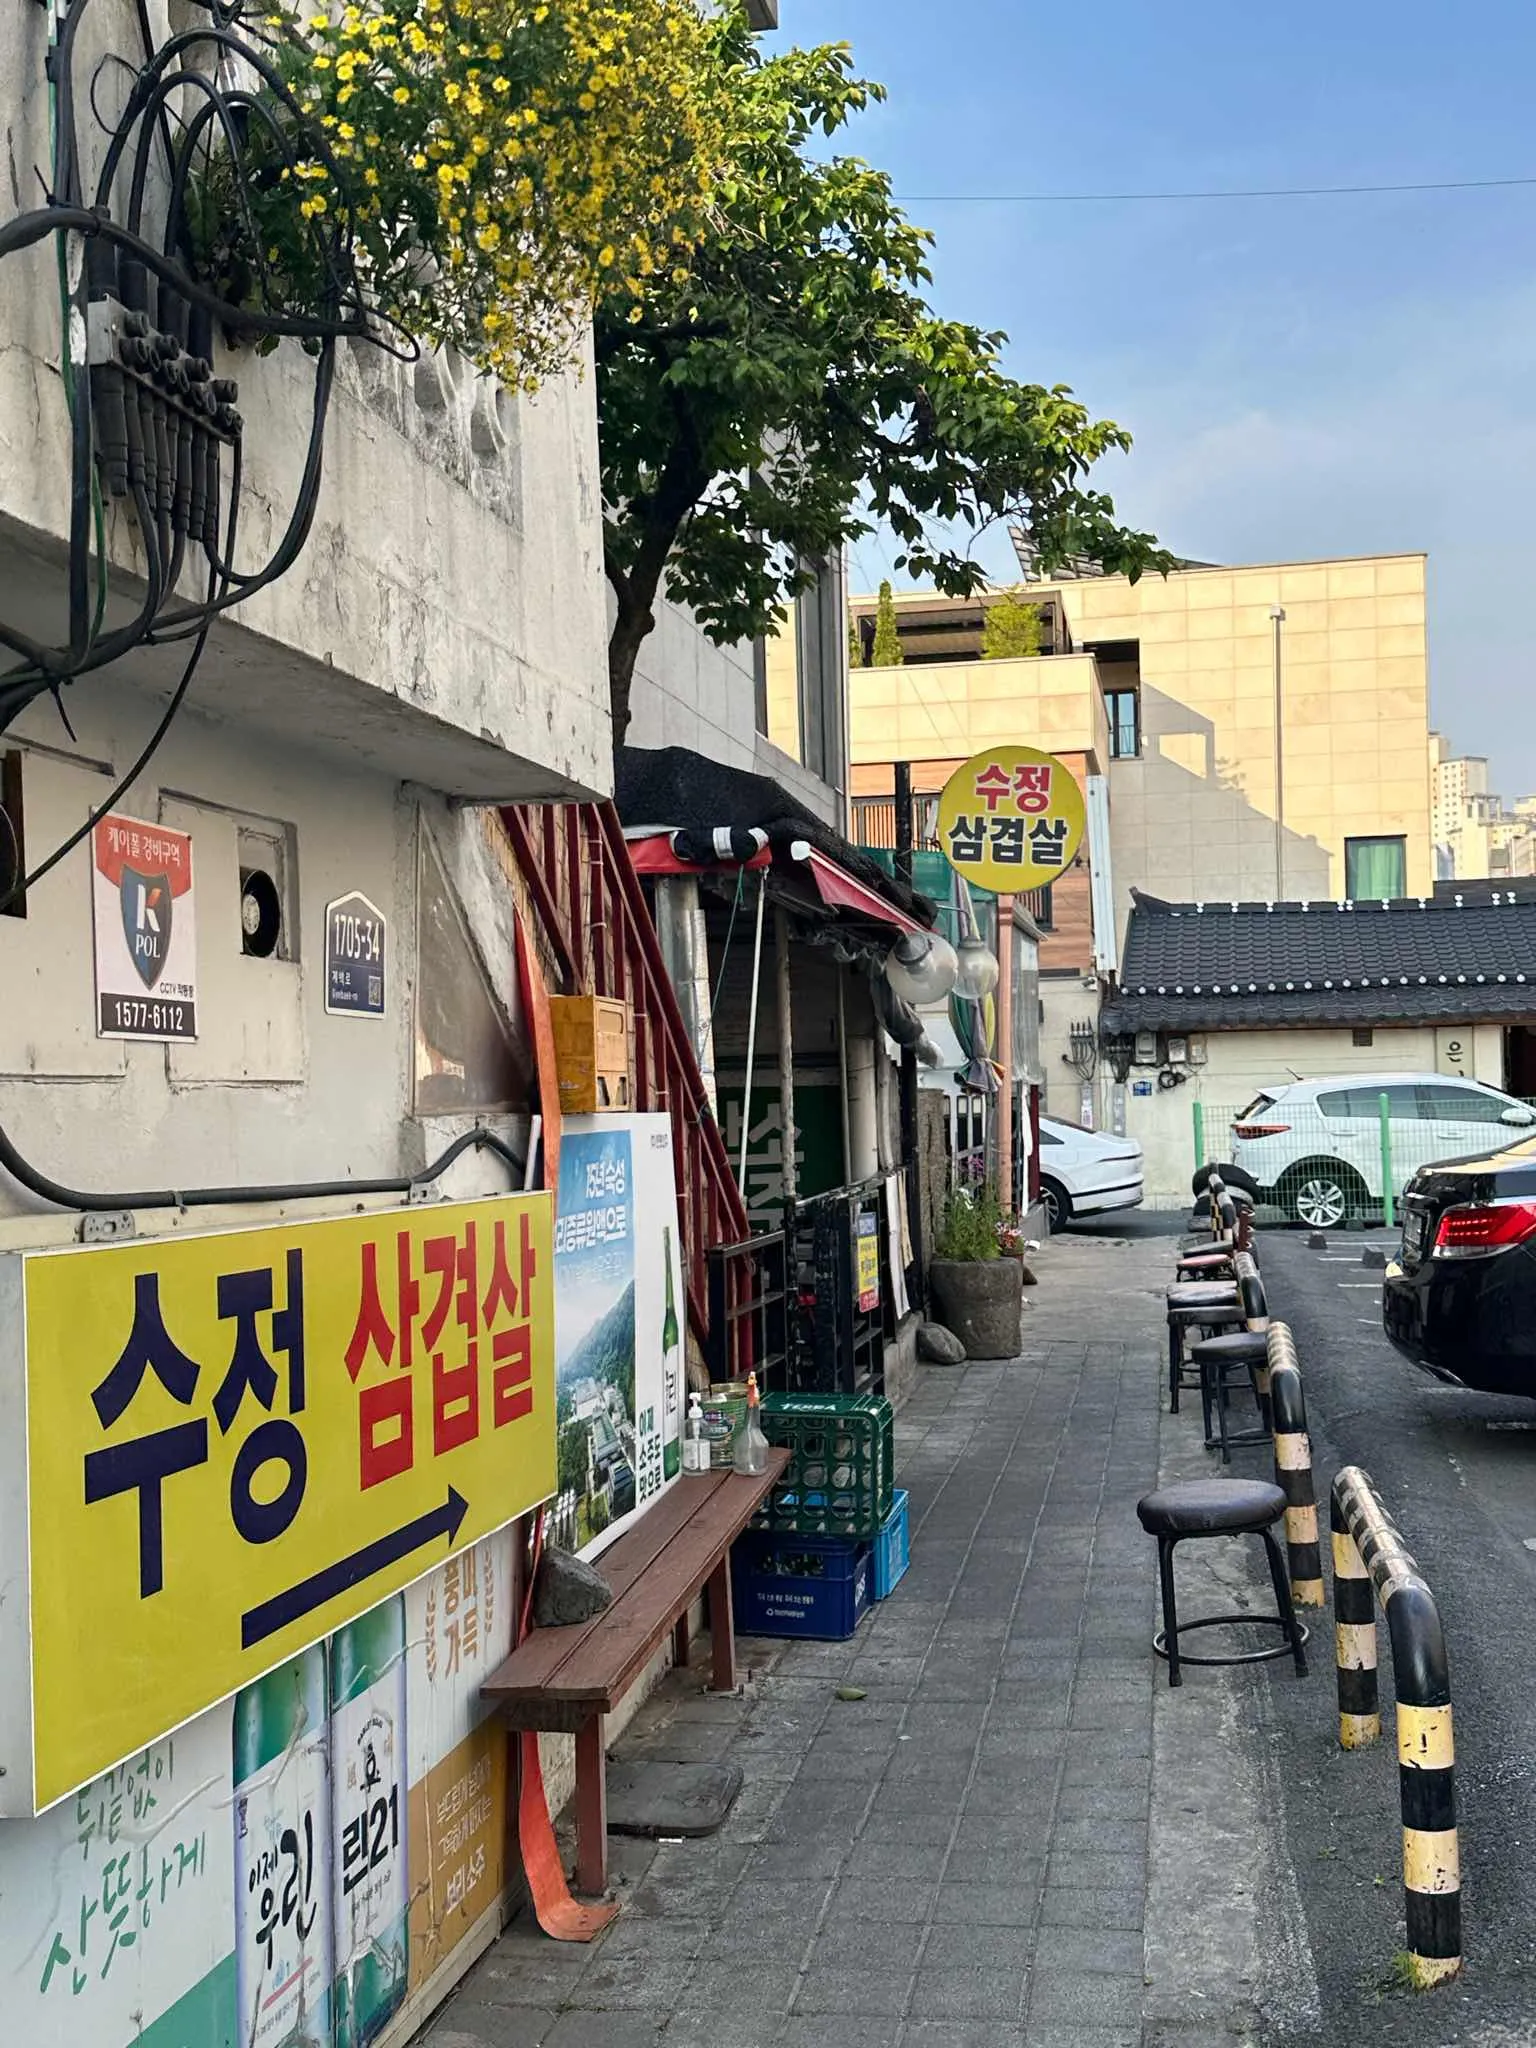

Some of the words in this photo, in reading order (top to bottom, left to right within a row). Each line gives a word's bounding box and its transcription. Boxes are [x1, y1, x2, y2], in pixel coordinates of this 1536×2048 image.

[975, 764, 1051, 814] 수정
[107, 826, 140, 858] 케이폴
[142, 835, 180, 868] 경비구역
[948, 815, 1068, 865] 삼겹살
[136, 883, 162, 932] K
[135, 933, 161, 958] POL
[334, 913, 380, 962] 1705-34
[160, 982, 176, 995] CCTV
[115, 1001, 183, 1031] 1577-6112
[84, 1247, 307, 1600] 수정
[344, 1213, 537, 1492] 삼겹살
[444, 1606, 478, 1680] 가득
[342, 1782, 399, 1897] 린21
[249, 1844, 279, 1894] 이제
[256, 1810, 318, 1972] 우린
[40, 1831, 206, 1996] 산뜻하게
